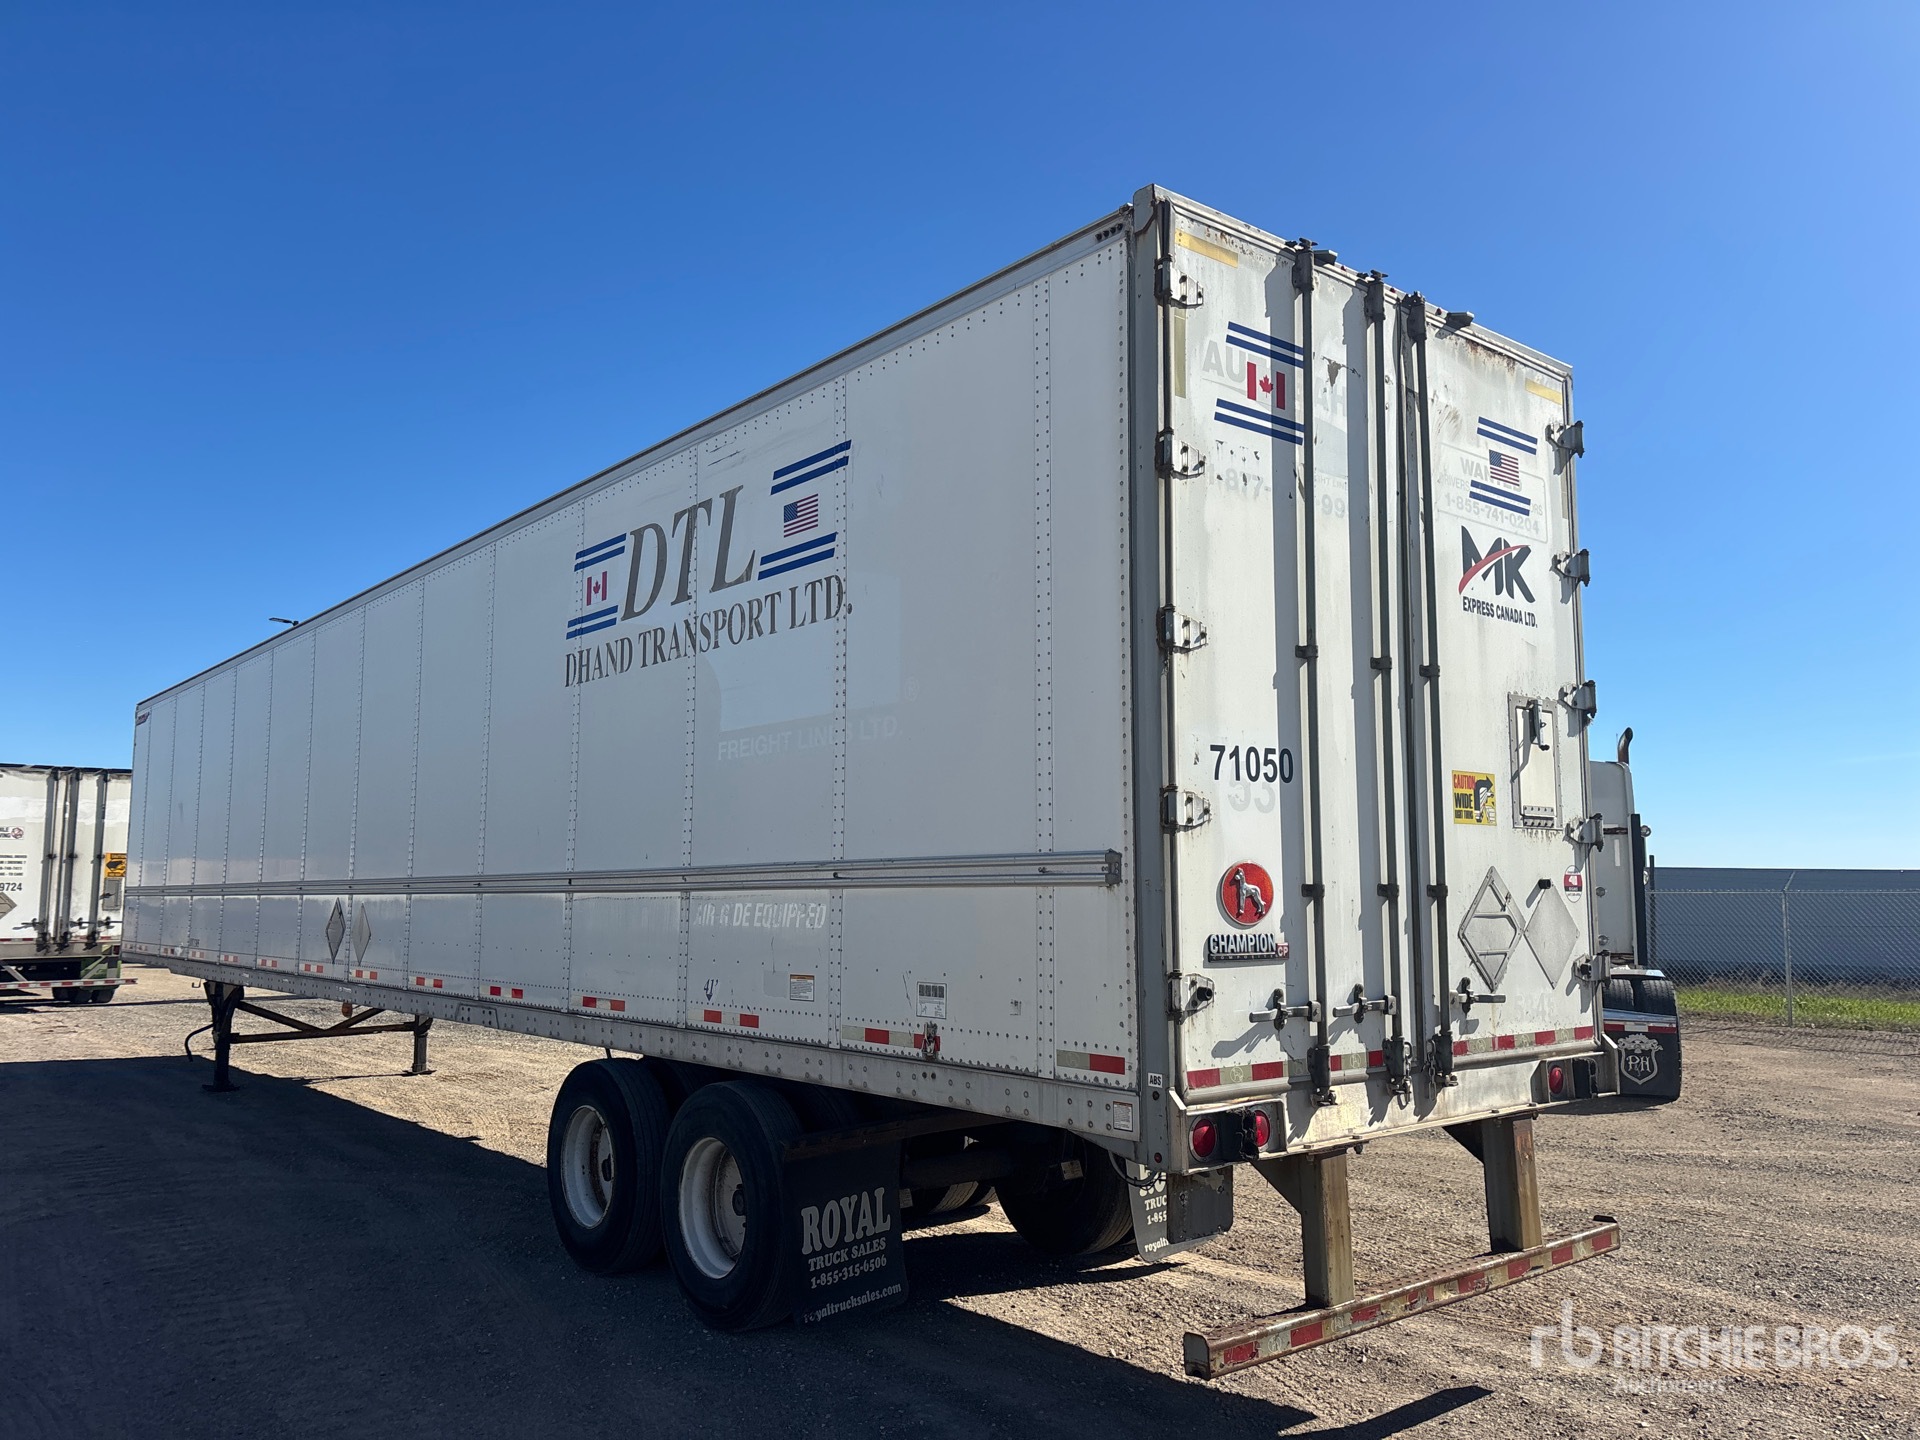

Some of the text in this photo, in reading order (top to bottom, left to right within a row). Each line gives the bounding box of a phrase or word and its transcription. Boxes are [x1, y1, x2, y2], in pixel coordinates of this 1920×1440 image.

[620, 484, 756, 622] DTL
[1460, 525, 1537, 604] MK
[1462, 596, 1538, 628] EXPRESS CANADA LTD.
[565, 573, 854, 688] DHAND TRANSPORT LTD.
[1209, 744, 1294, 784] 71050
[1453, 792, 1474, 809] WIDE
[1209, 933, 1277, 954] CHAMPION
[1277, 946, 1289, 957] CP
[1149, 1074, 1163, 1086] ABS
[800, 1187, 891, 1255] ROYAL
[808, 1236, 887, 1272] TRUCK SALES
[810, 1253, 888, 1289] 1-855-315-6506
